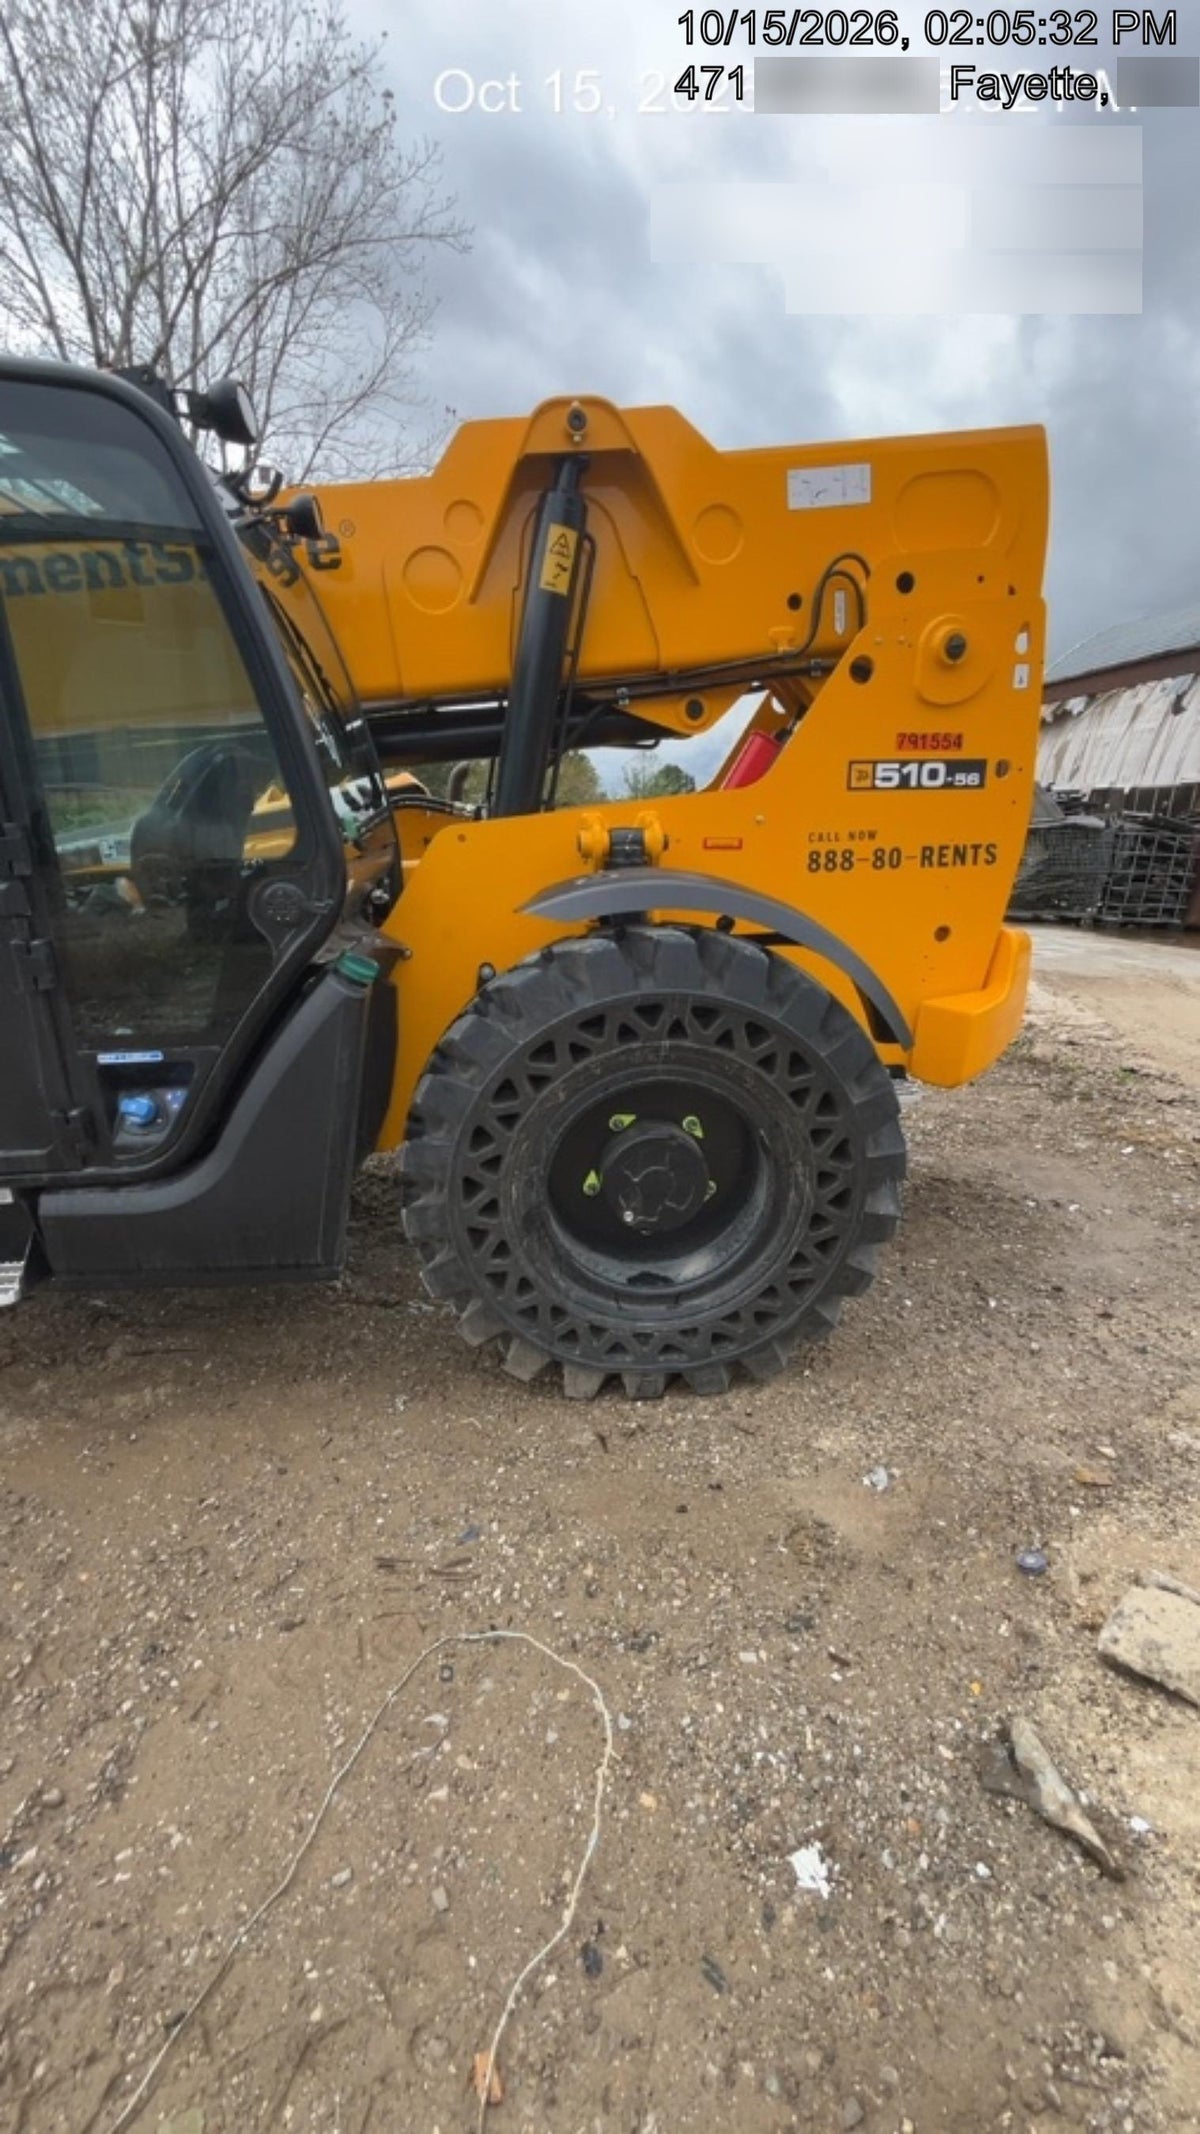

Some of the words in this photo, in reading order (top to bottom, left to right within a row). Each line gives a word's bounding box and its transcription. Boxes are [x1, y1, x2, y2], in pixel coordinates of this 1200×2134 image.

[896, 732, 964, 750] 791554
[808, 831, 841, 843] CALL
[848, 829, 878, 841] NOW
[807, 843, 998, 873] 888-80-RENTS
